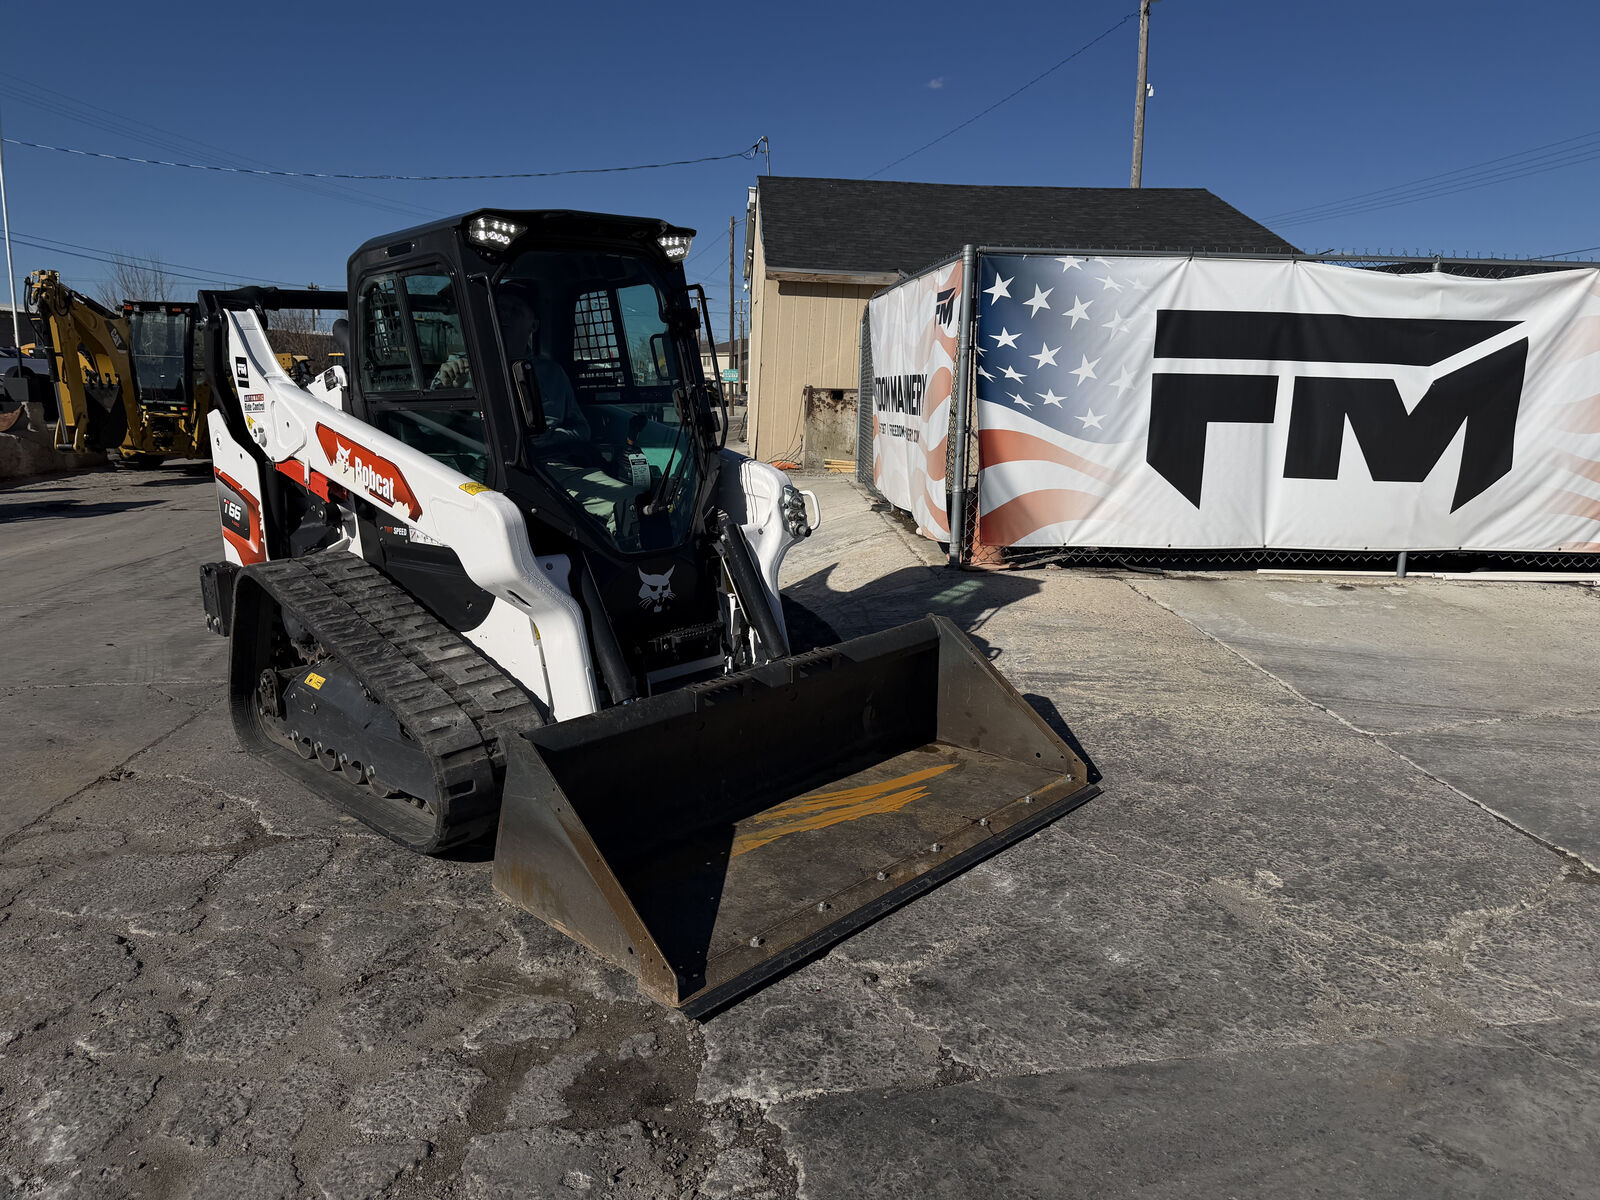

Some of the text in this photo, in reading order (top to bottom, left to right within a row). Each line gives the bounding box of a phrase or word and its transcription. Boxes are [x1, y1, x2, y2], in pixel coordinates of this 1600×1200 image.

[110, 328, 122, 347] CAT
[1146, 309, 1529, 514] FM
[354, 456, 394, 502] Bobcat
[224, 498, 241, 521] T66
[393, 527, 407, 536] SPEED
